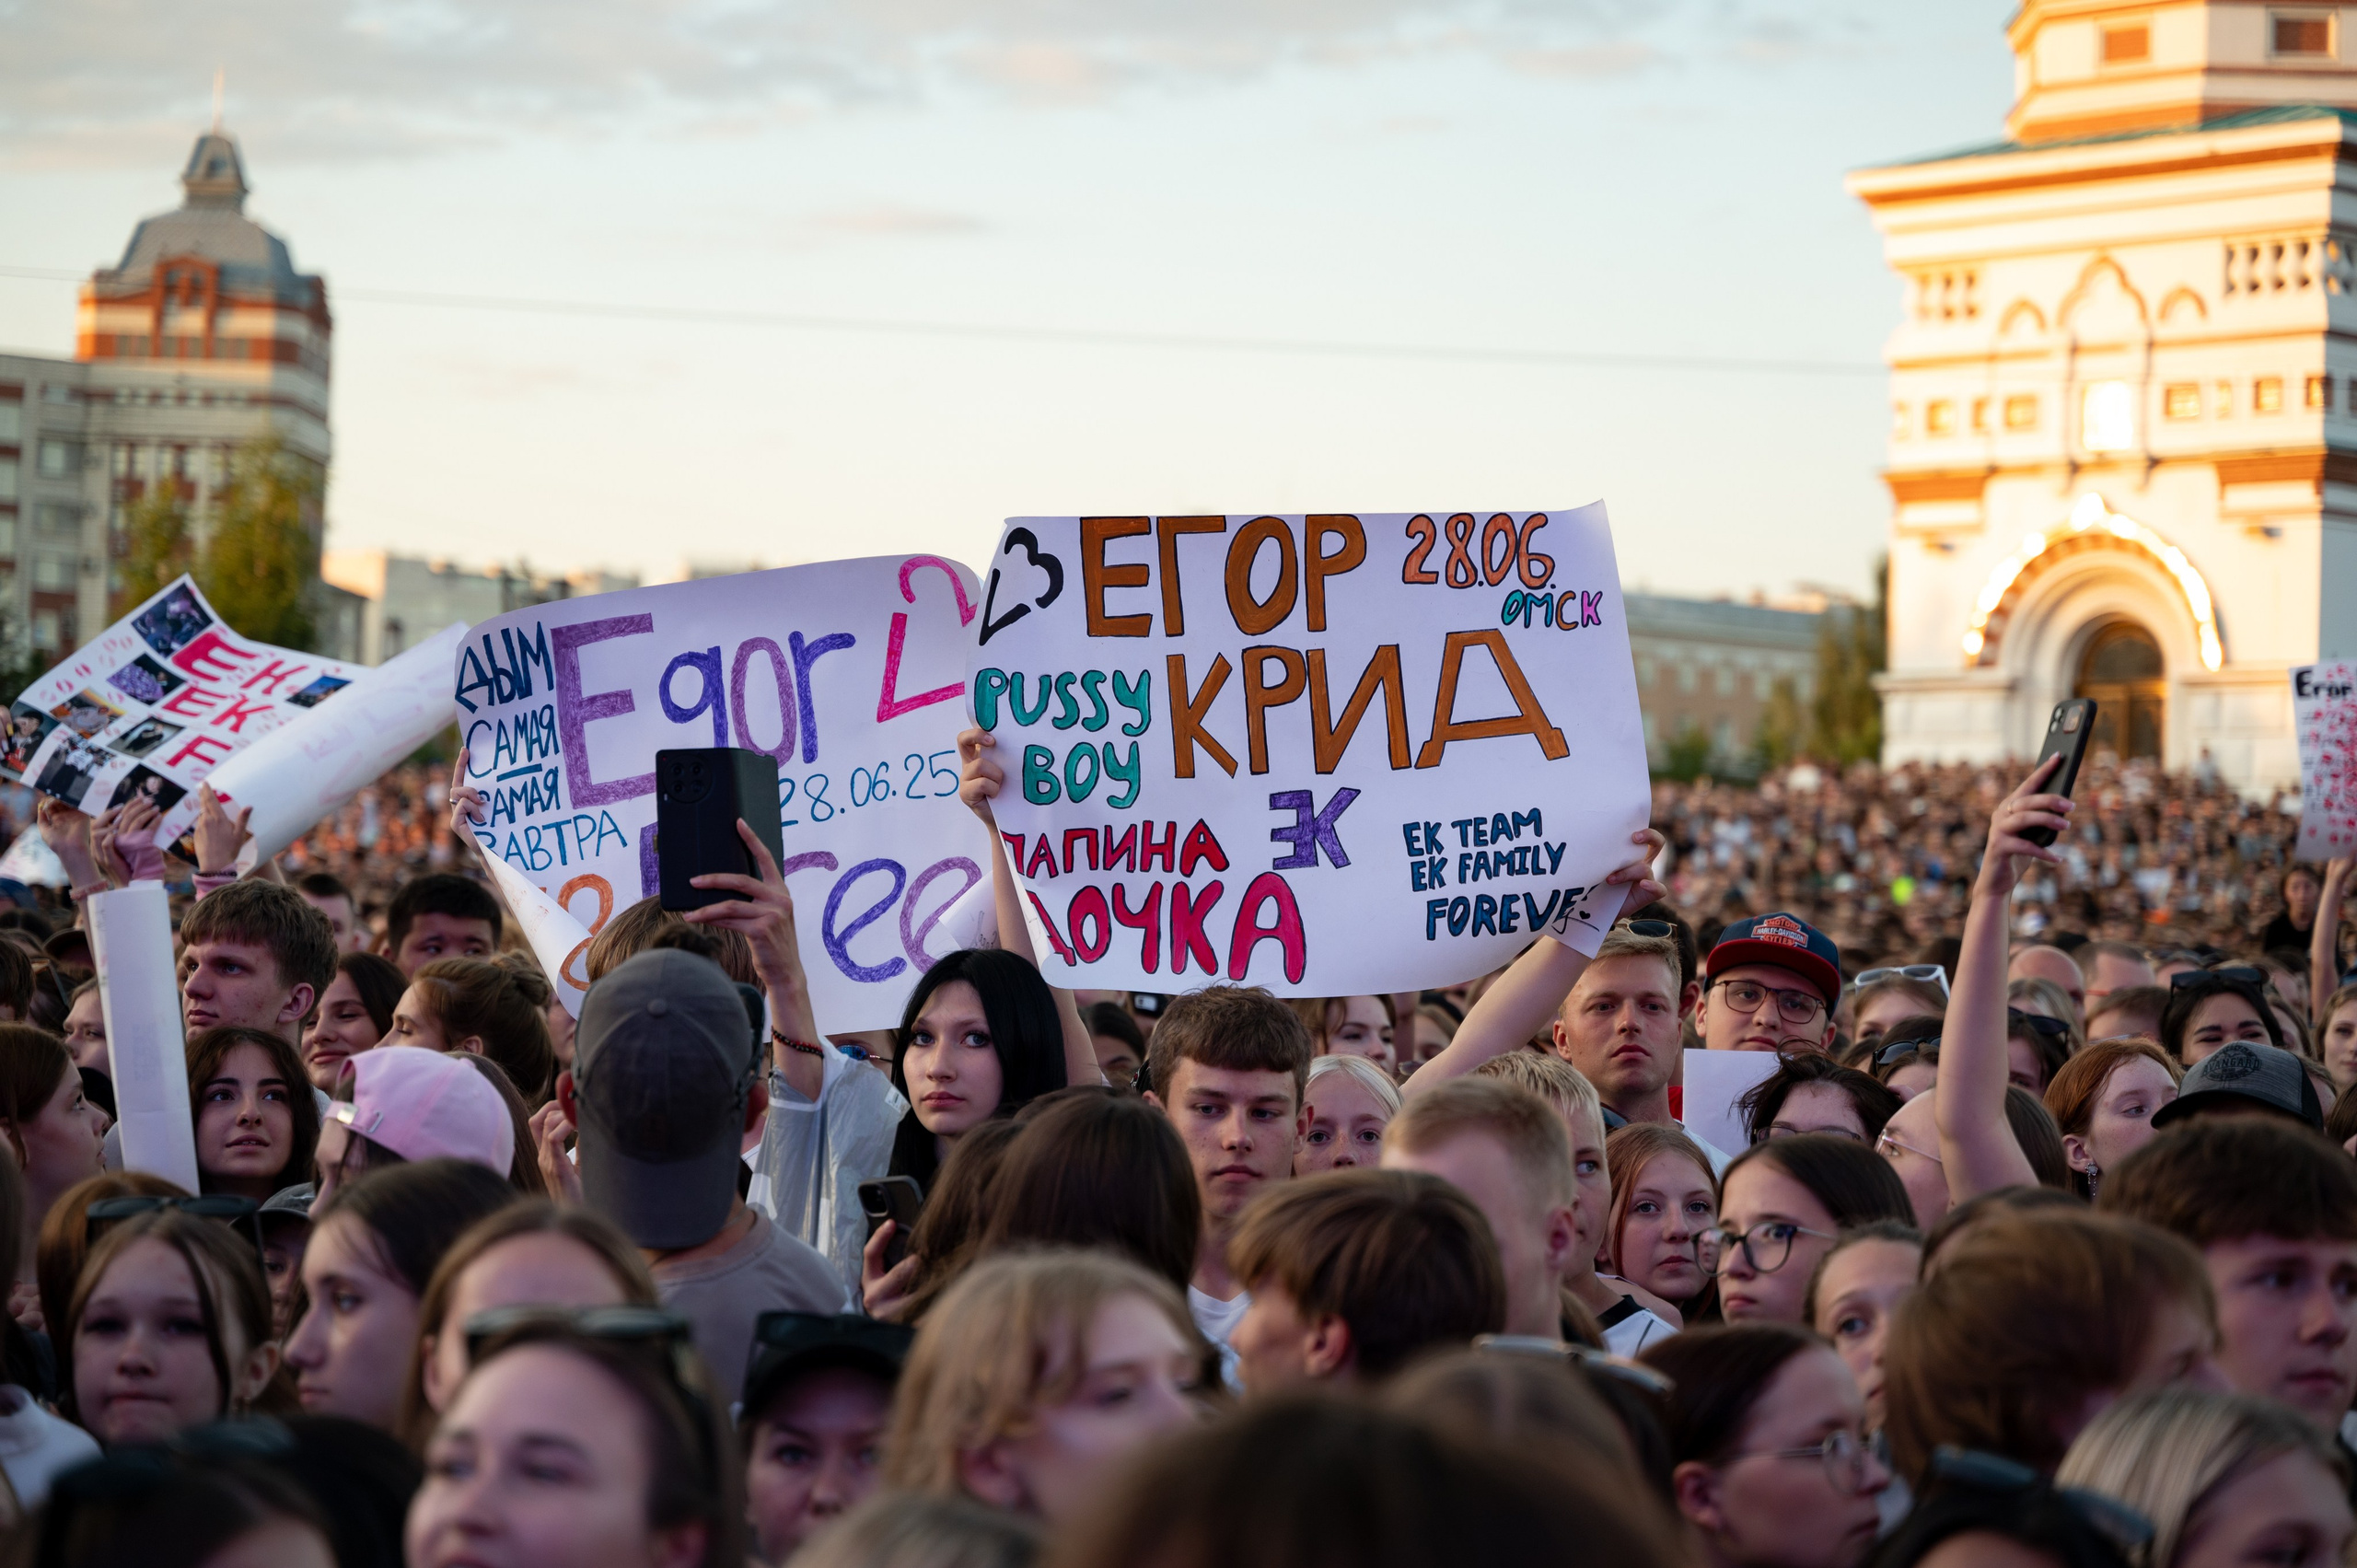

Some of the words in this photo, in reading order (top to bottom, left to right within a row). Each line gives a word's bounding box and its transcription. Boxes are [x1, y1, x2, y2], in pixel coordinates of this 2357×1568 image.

[1079, 513, 1367, 637] ЕГОР
[1501, 589, 1603, 631] ОМСК
[455, 621, 554, 714] ДЫМ
[974, 668, 1151, 737] PUSSY
[1166, 628, 1570, 780] КРИД
[466, 704, 560, 779] САМАЯ
[1022, 740, 1141, 808] BOY
[777, 750, 959, 827] 28.06.25
[1402, 821, 1444, 857] EK
[1452, 807, 1542, 848] TEAM
[1411, 856, 1446, 892] EK
[1457, 842, 1567, 885] FAMILY
[1426, 884, 1591, 941] FOREVE
[1756, 927, 1805, 943] HARLEY-DAVIDSON
